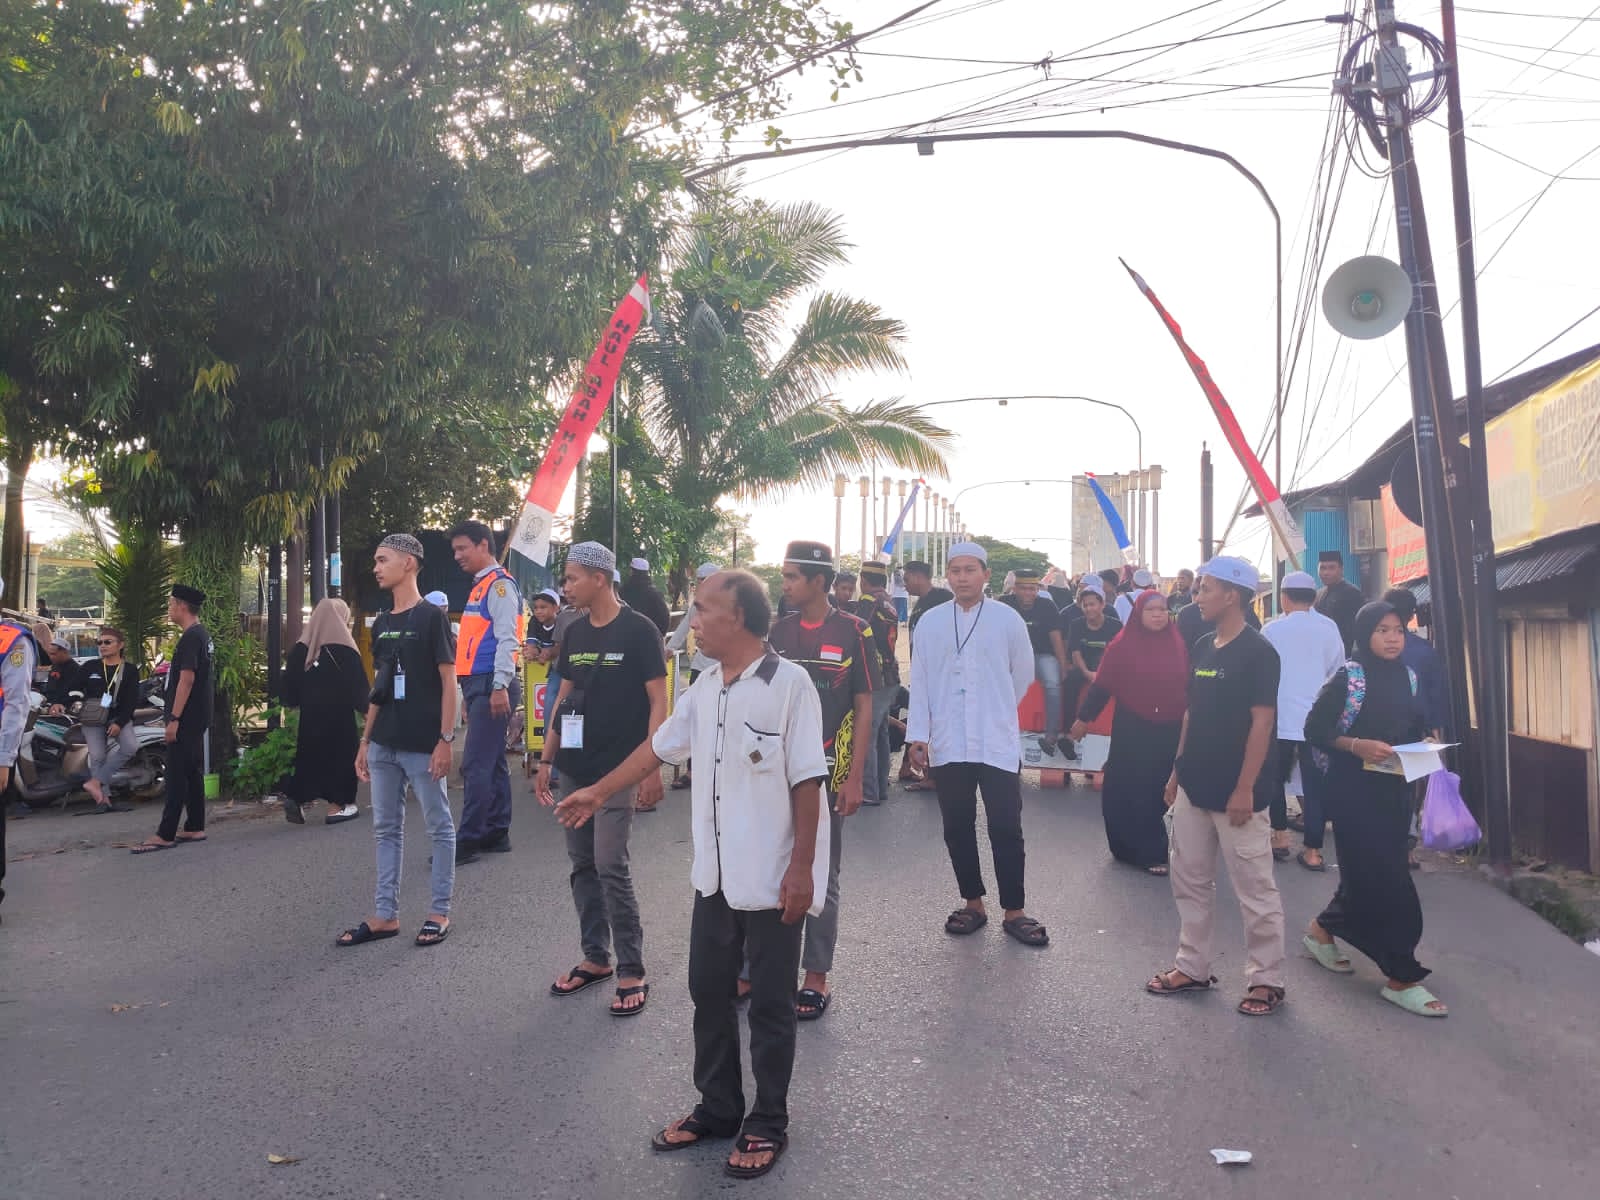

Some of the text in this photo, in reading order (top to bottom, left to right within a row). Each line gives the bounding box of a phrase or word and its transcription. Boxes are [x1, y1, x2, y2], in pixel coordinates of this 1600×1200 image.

[601, 319, 631, 366] HAUL
[572, 375, 602, 422] ABAH
[1542, 391, 1577, 435] AYAM
